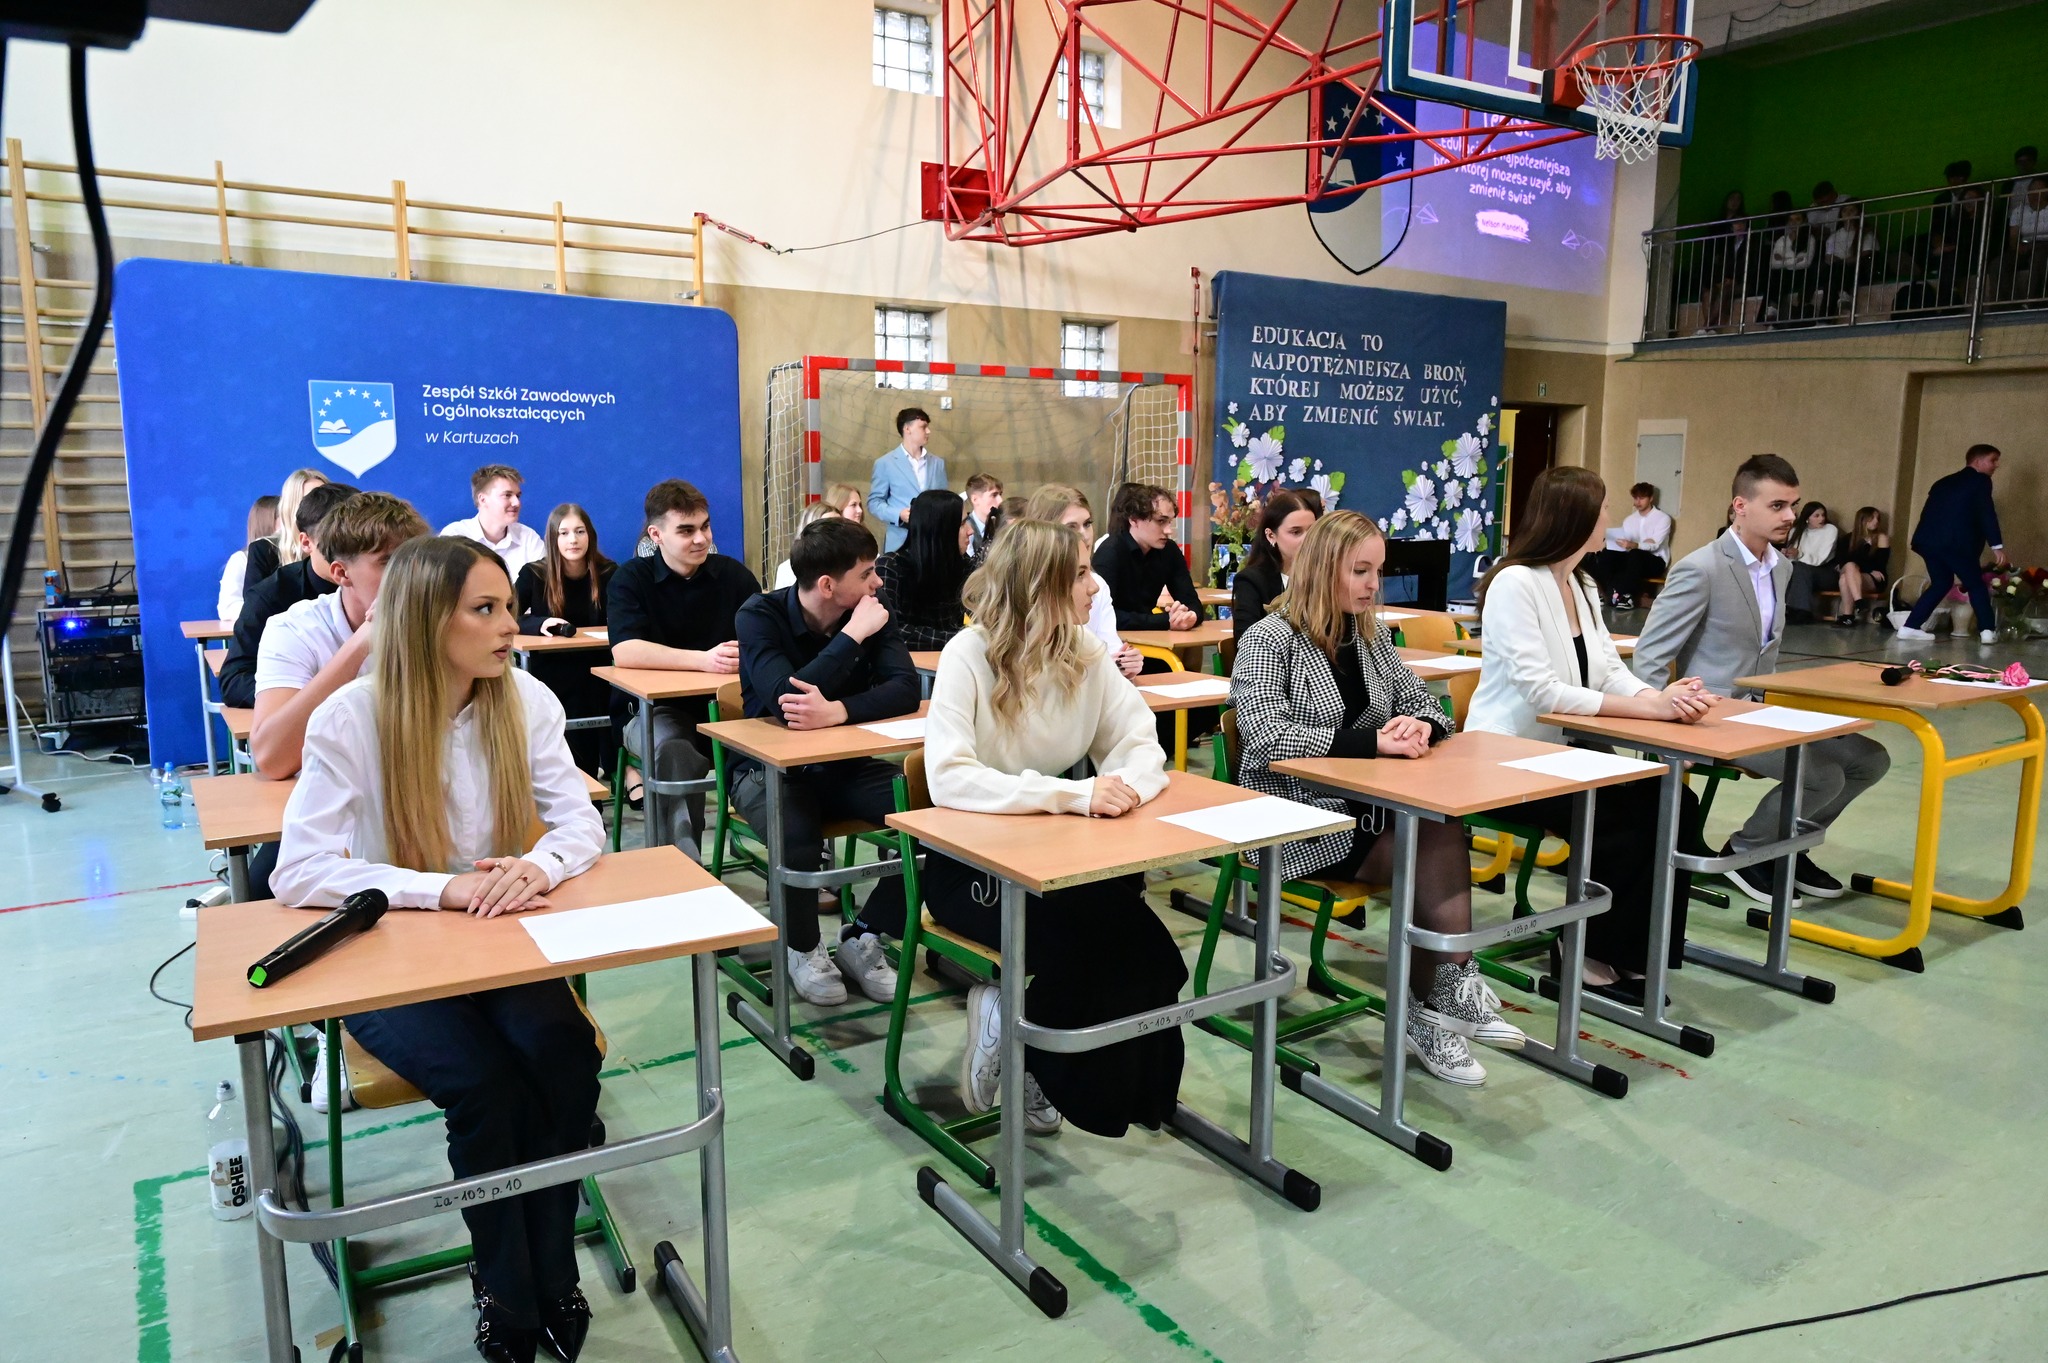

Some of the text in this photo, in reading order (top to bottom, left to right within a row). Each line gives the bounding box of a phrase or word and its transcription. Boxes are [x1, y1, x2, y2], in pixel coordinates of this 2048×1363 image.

[1555, 180, 1572, 200] aby
[1251, 325, 1384, 352] EDUKACJA TO
[1250, 351, 1467, 387] NAJPOTĘŻNIEJSZA BROŃ,
[422, 383, 616, 405] Zespół Szkół Zawodowych
[1249, 371, 1463, 409] KTÓREJ MOŻESZ UŻYĆ,
[423, 403, 586, 424] i Ogólnokształcących
[1249, 403, 1446, 428] ABY ZMIENIĆ ŚWIAT.
[425, 430, 520, 445] w Kartuzach
[229, 1154, 246, 1207] OSHEE
